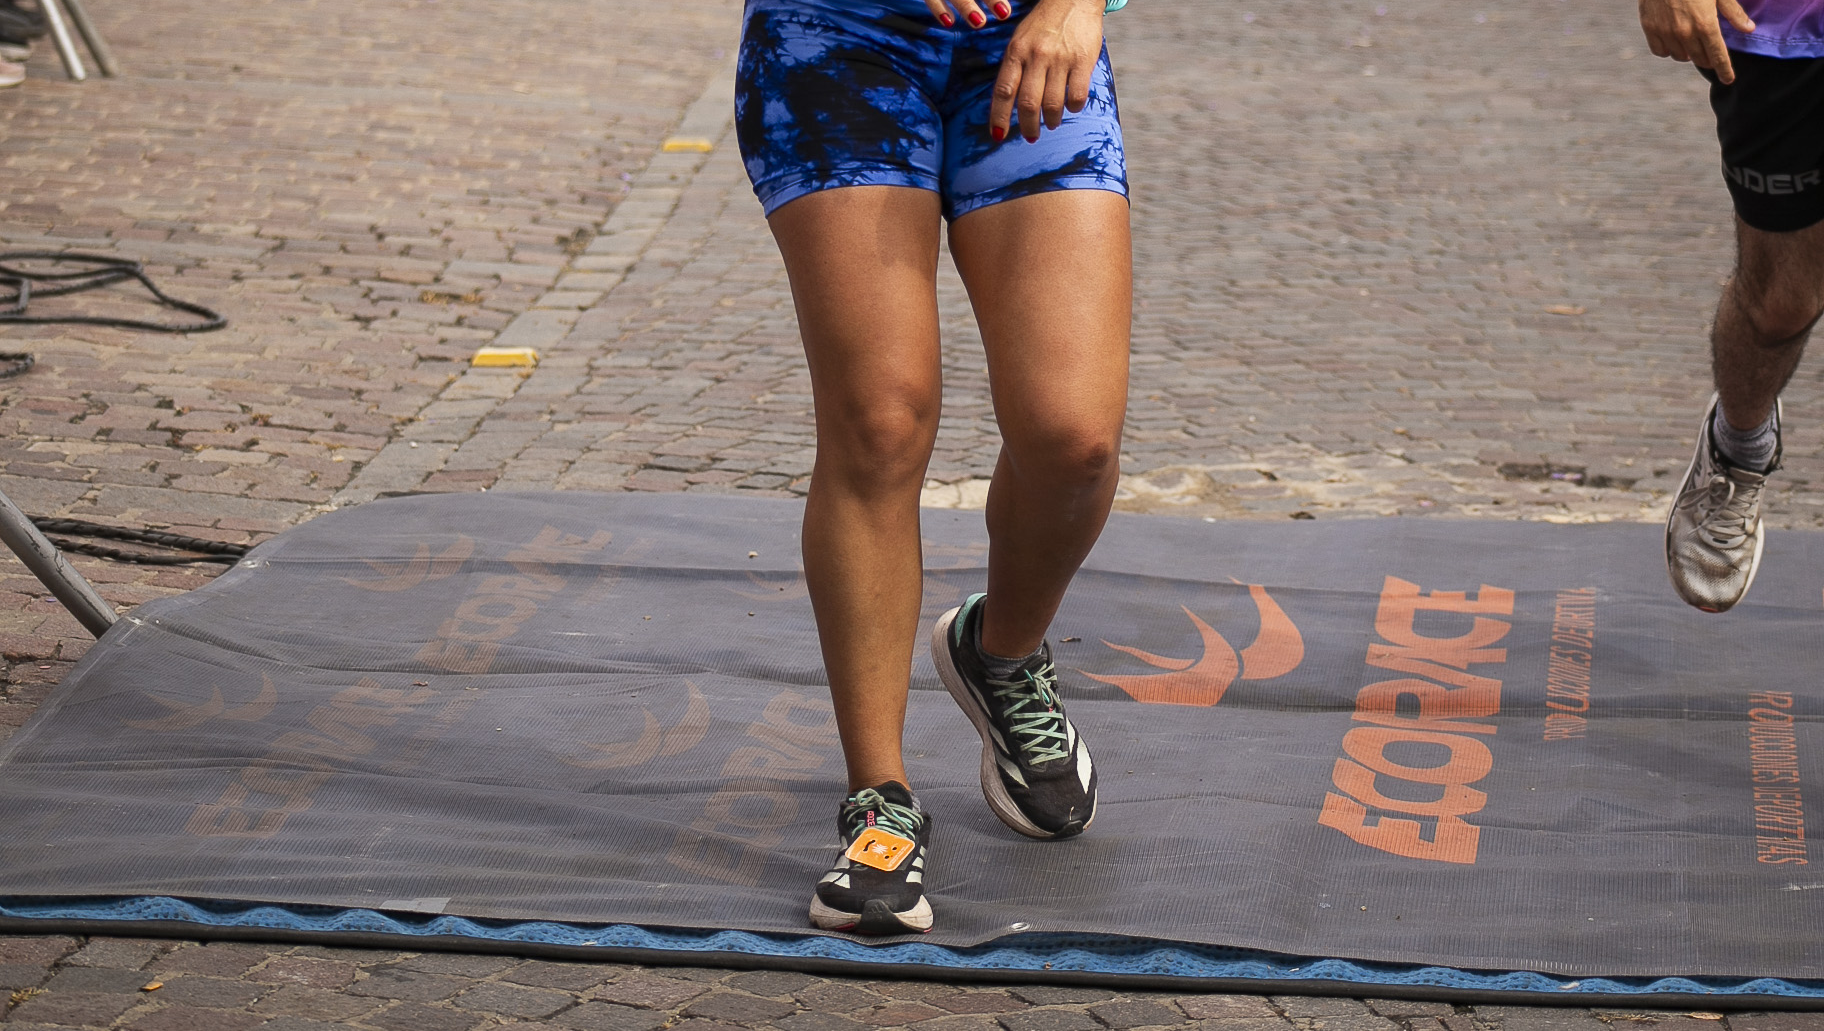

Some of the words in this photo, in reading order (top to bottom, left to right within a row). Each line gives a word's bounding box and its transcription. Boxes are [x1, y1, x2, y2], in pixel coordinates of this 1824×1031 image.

[1722, 160, 1821, 195] NDER
[1552, 587, 1597, 649] DEPORTIVA
[1317, 575, 1515, 865] ECORACE
